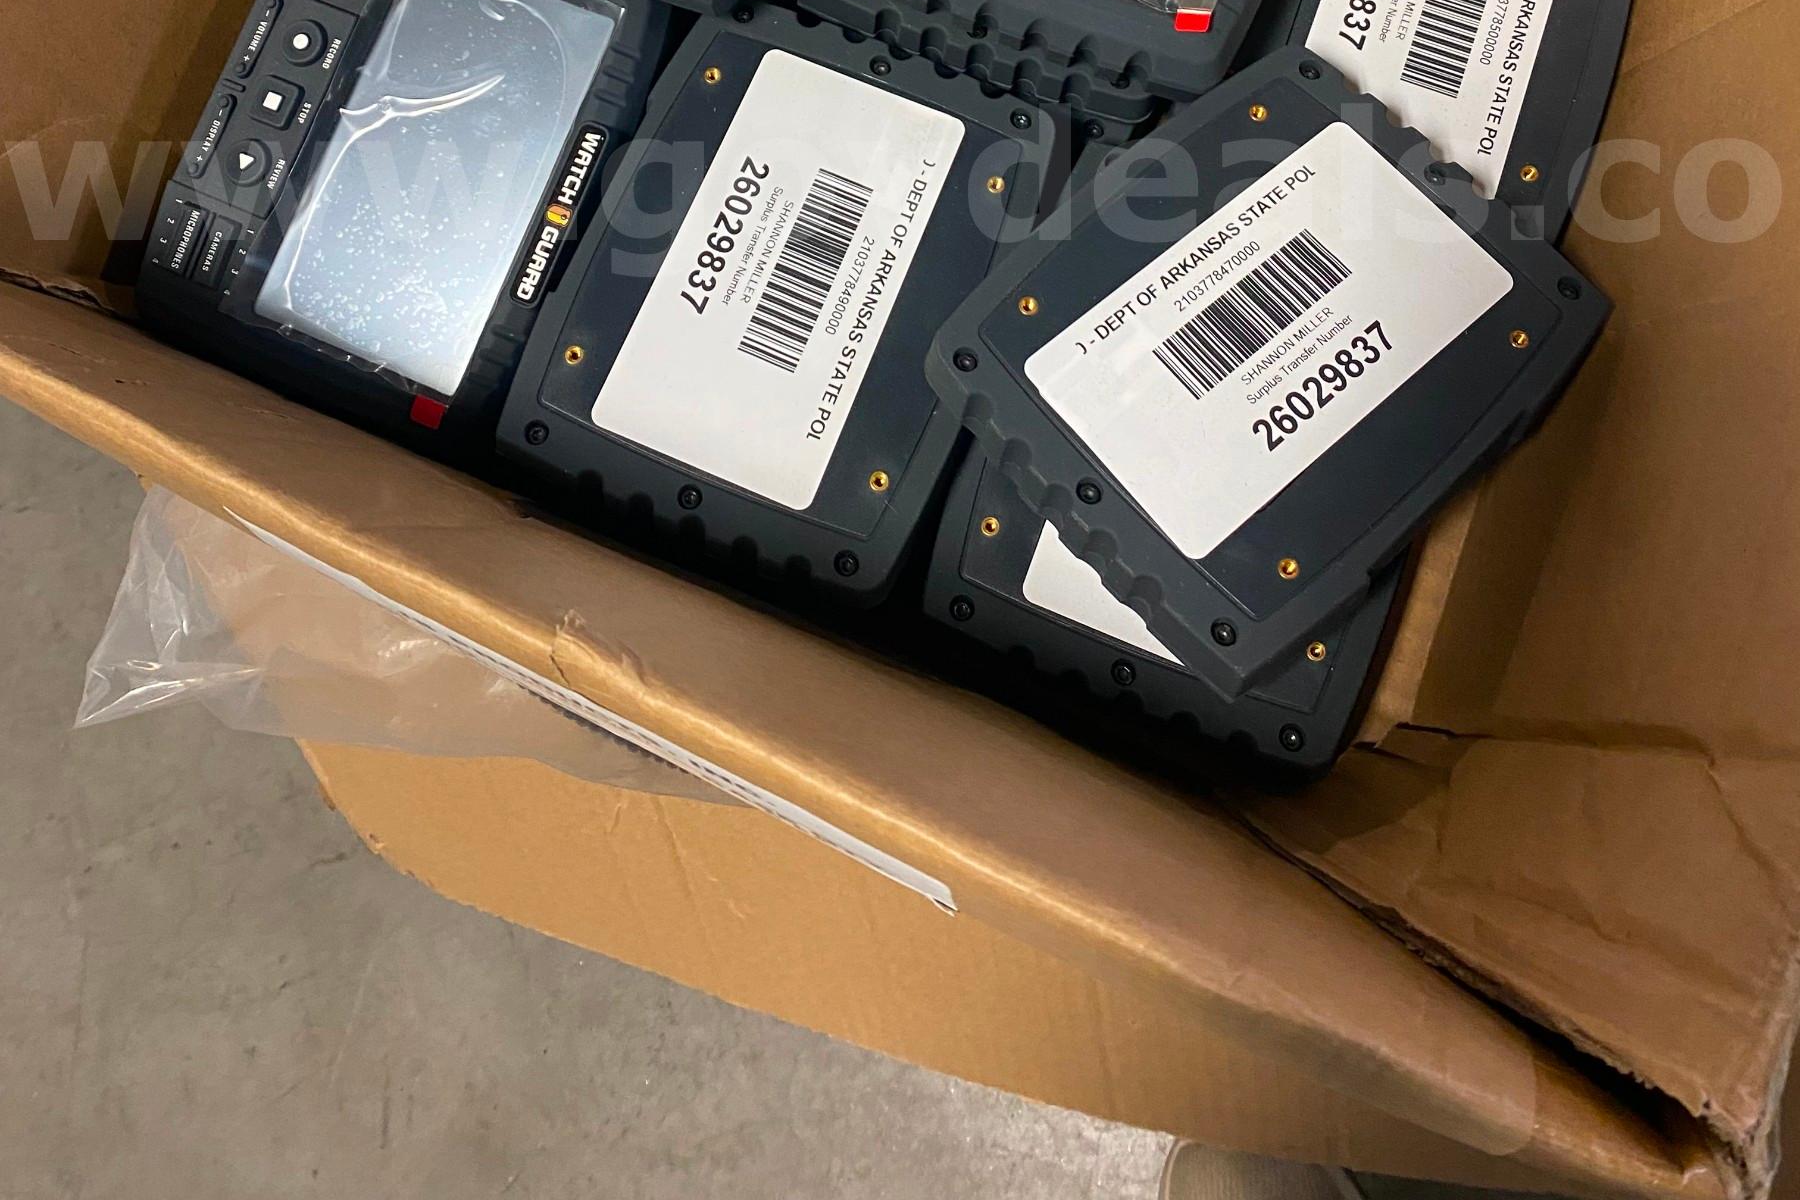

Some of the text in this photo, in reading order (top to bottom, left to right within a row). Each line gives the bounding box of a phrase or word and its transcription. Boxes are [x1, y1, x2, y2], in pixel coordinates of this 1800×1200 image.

[248, 22, 267, 51] VOLUME
[1379, 8, 1397, 43] Number
[1395, 1, 1415, 40] MILLER
[322, 39, 341, 69] RECORD
[298, 102, 311, 123] STOP
[1487, 74, 1512, 124] STATE
[202, 120, 220, 151] DISPLAY
[267, 159, 285, 189] REVIEW
[900, 179, 927, 223] DEPT
[171, 210, 200, 268] MICROPHONES
[516, 132, 602, 300] WATCH GUARD
[680, 156, 769, 314] 26029837
[890, 224, 907, 248] OF
[202, 231, 222, 271] CAMERAS
[722, 186, 783, 305] Surplus Transfer Number
[740, 200, 794, 303] SHANNON MILLER
[1094, 301, 1136, 340] DEPT
[1136, 284, 1157, 306] OF
[1160, 223, 1240, 290] ARKANSAS
[1238, 186, 1288, 226] STATE
[825, 236, 874, 335] 2103778490000
[848, 249, 896, 343] ARKANSAS
[1174, 241, 1260, 312] 2103778470000
[1241, 307, 1334, 385] SHANNON MILLER
[1246, 315, 1352, 404] Surplus Transfer Number
[822, 346, 856, 405] STATE
[1252, 321, 1394, 451] 26029837
